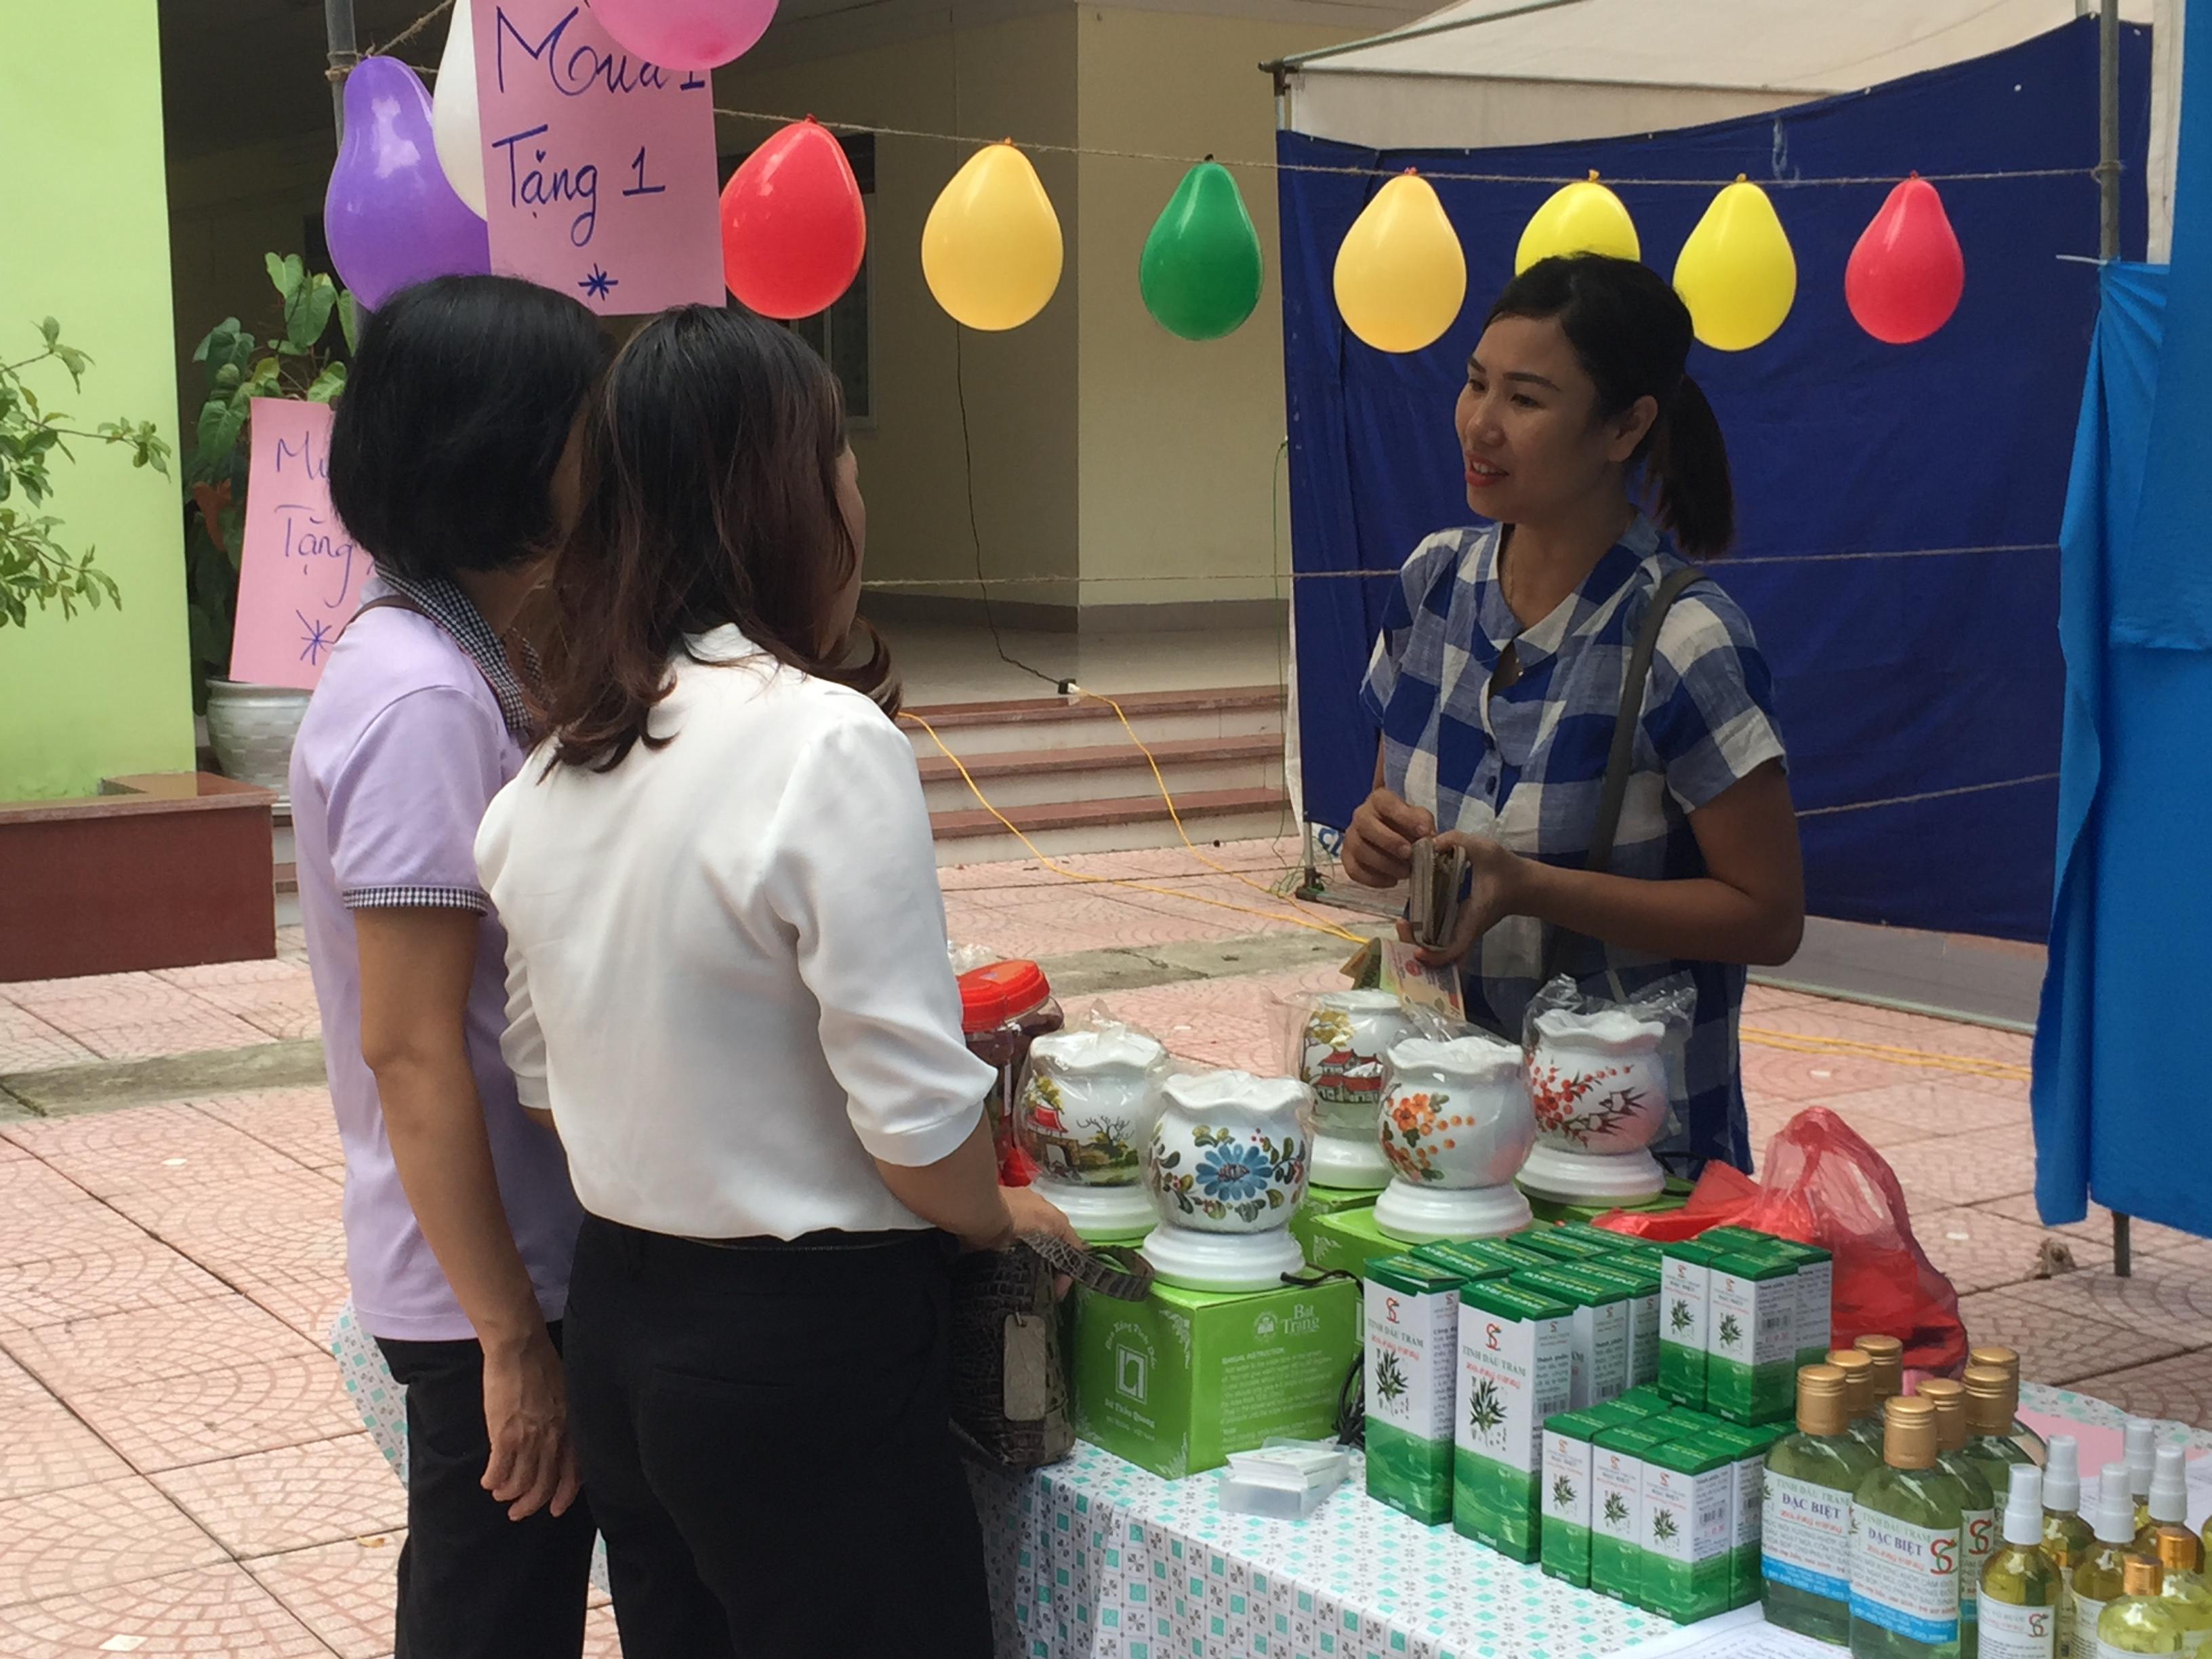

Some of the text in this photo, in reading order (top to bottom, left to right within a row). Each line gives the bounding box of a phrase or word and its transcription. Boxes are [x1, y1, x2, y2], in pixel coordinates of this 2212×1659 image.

[496, 6, 669, 96] Mua
[492, 124, 665, 247] Tặng 1
[274, 504, 352, 608] Tặng
